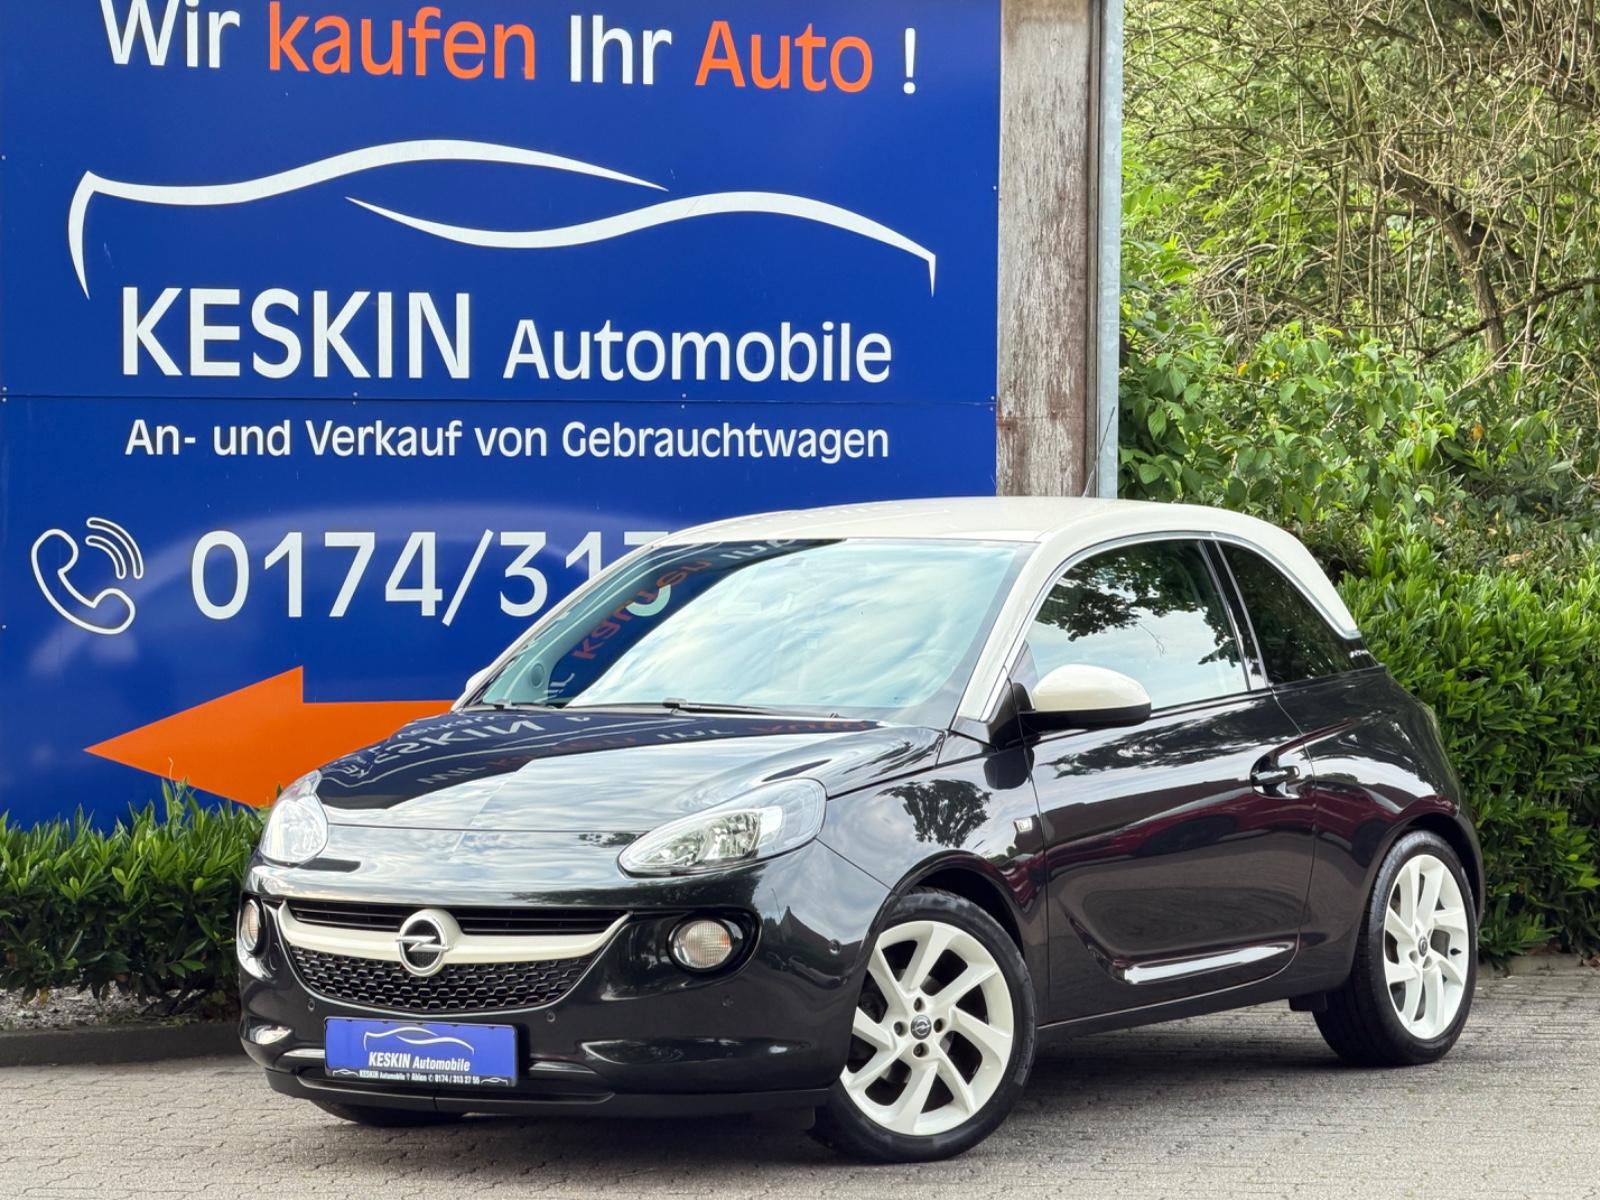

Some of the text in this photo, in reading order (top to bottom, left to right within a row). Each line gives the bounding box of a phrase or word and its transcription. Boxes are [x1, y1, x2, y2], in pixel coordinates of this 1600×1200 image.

[100, 0, 917, 95] Wir kaufen Ihr Auto !
[122, 286, 892, 383] KESKIN Automobile
[126, 419, 889, 465] An- und Verkauf von Gebrauchtwagen
[368, 1051, 471, 1072] KESKIN Automobile
